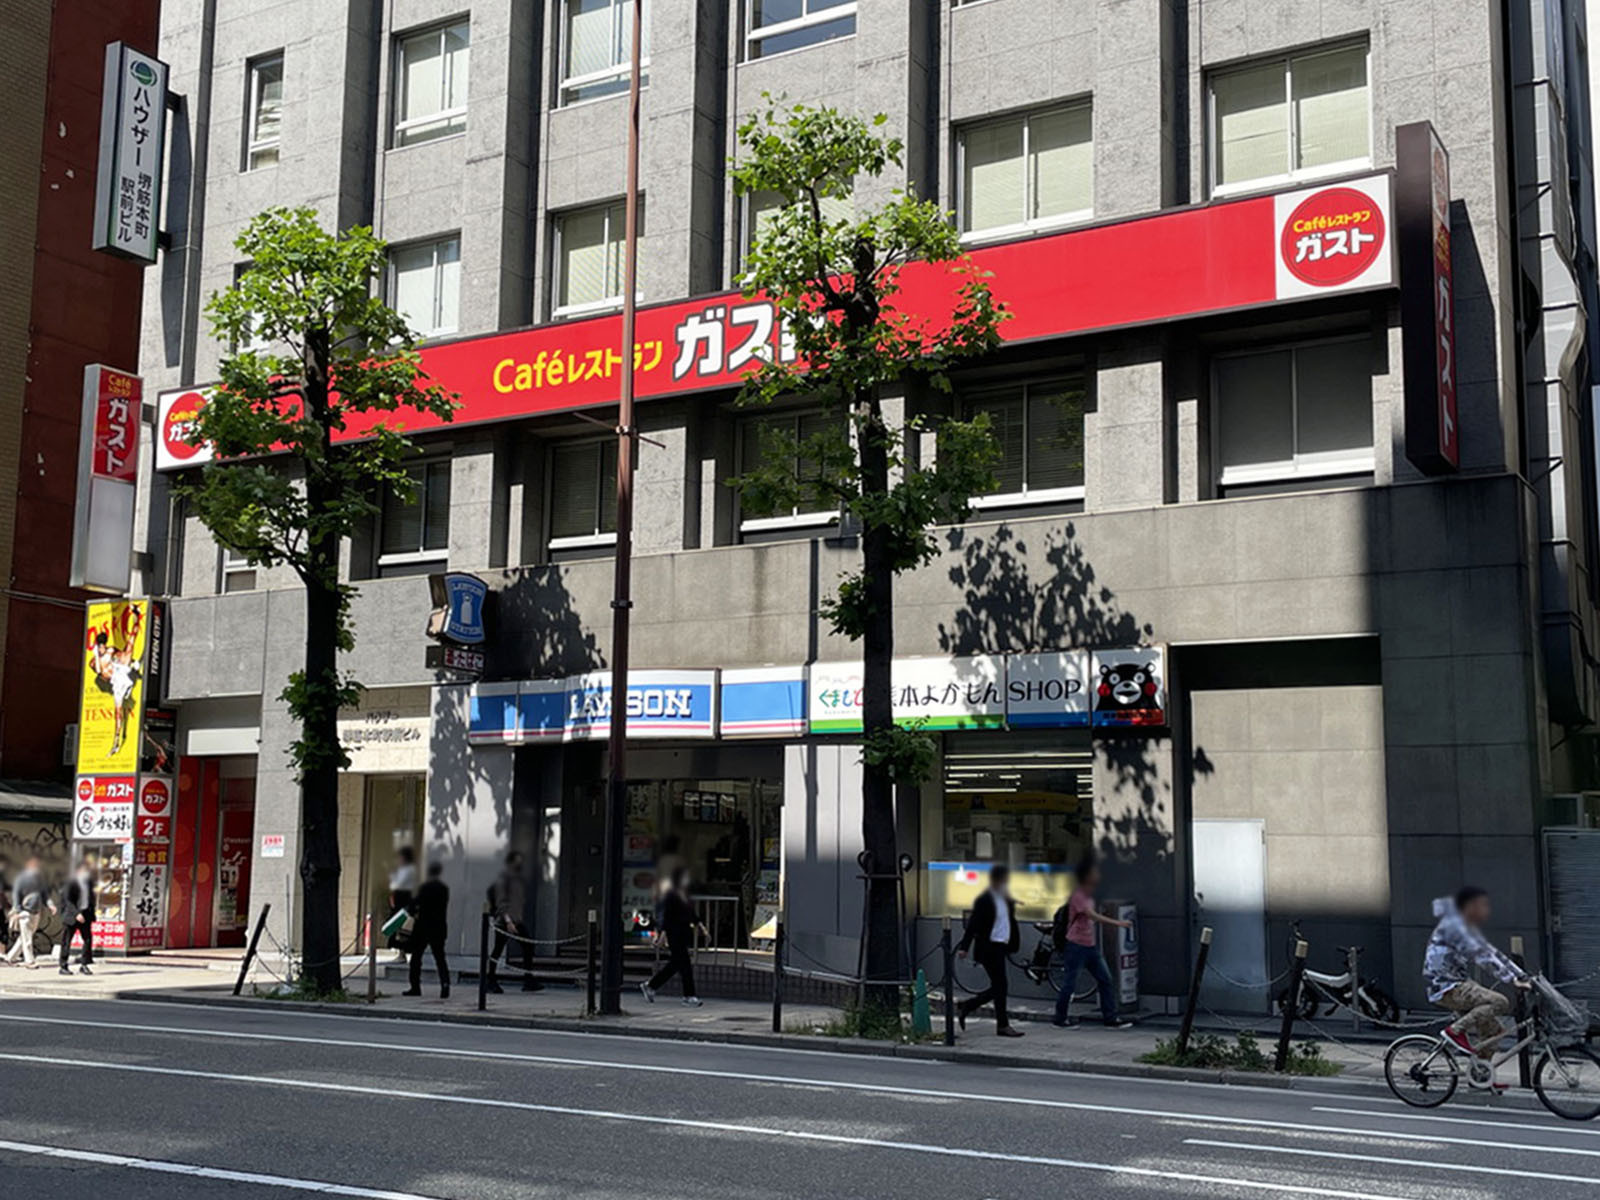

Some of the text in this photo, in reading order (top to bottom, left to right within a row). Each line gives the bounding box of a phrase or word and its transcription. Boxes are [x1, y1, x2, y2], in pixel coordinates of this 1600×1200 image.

[131, 87, 151, 166] ハウザー
[118, 176, 136, 243] 駅前ビル
[1293, 210, 1371, 233] Caféレストラン
[1295, 227, 1375, 263] ガスト
[108, 374, 132, 388] Café
[105, 397, 129, 473] ガスト
[890, 684, 1001, 708] 本よかもん
[1009, 679, 1081, 702] SHOP
[106, 783, 134, 798] ガスト
[143, 818, 164, 836] 2F
[136, 865, 154, 928] から好し
